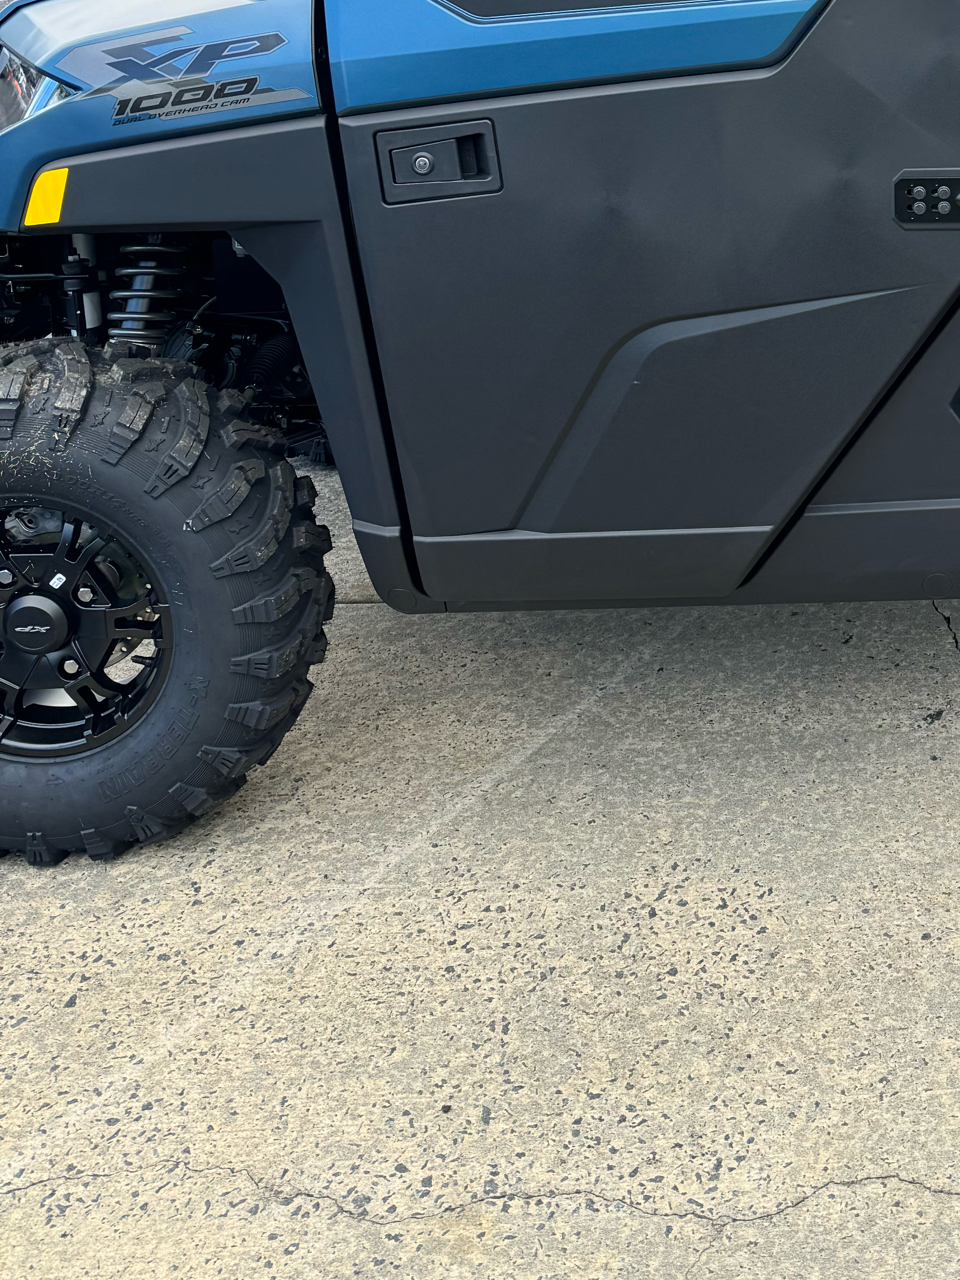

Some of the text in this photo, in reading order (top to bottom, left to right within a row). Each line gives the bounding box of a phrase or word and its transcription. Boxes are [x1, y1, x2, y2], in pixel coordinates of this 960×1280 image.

[97, 32, 289, 88] XP
[112, 97, 250, 126] DUAL OVERHEAD CAM
[113, 76, 259, 117] 1000
